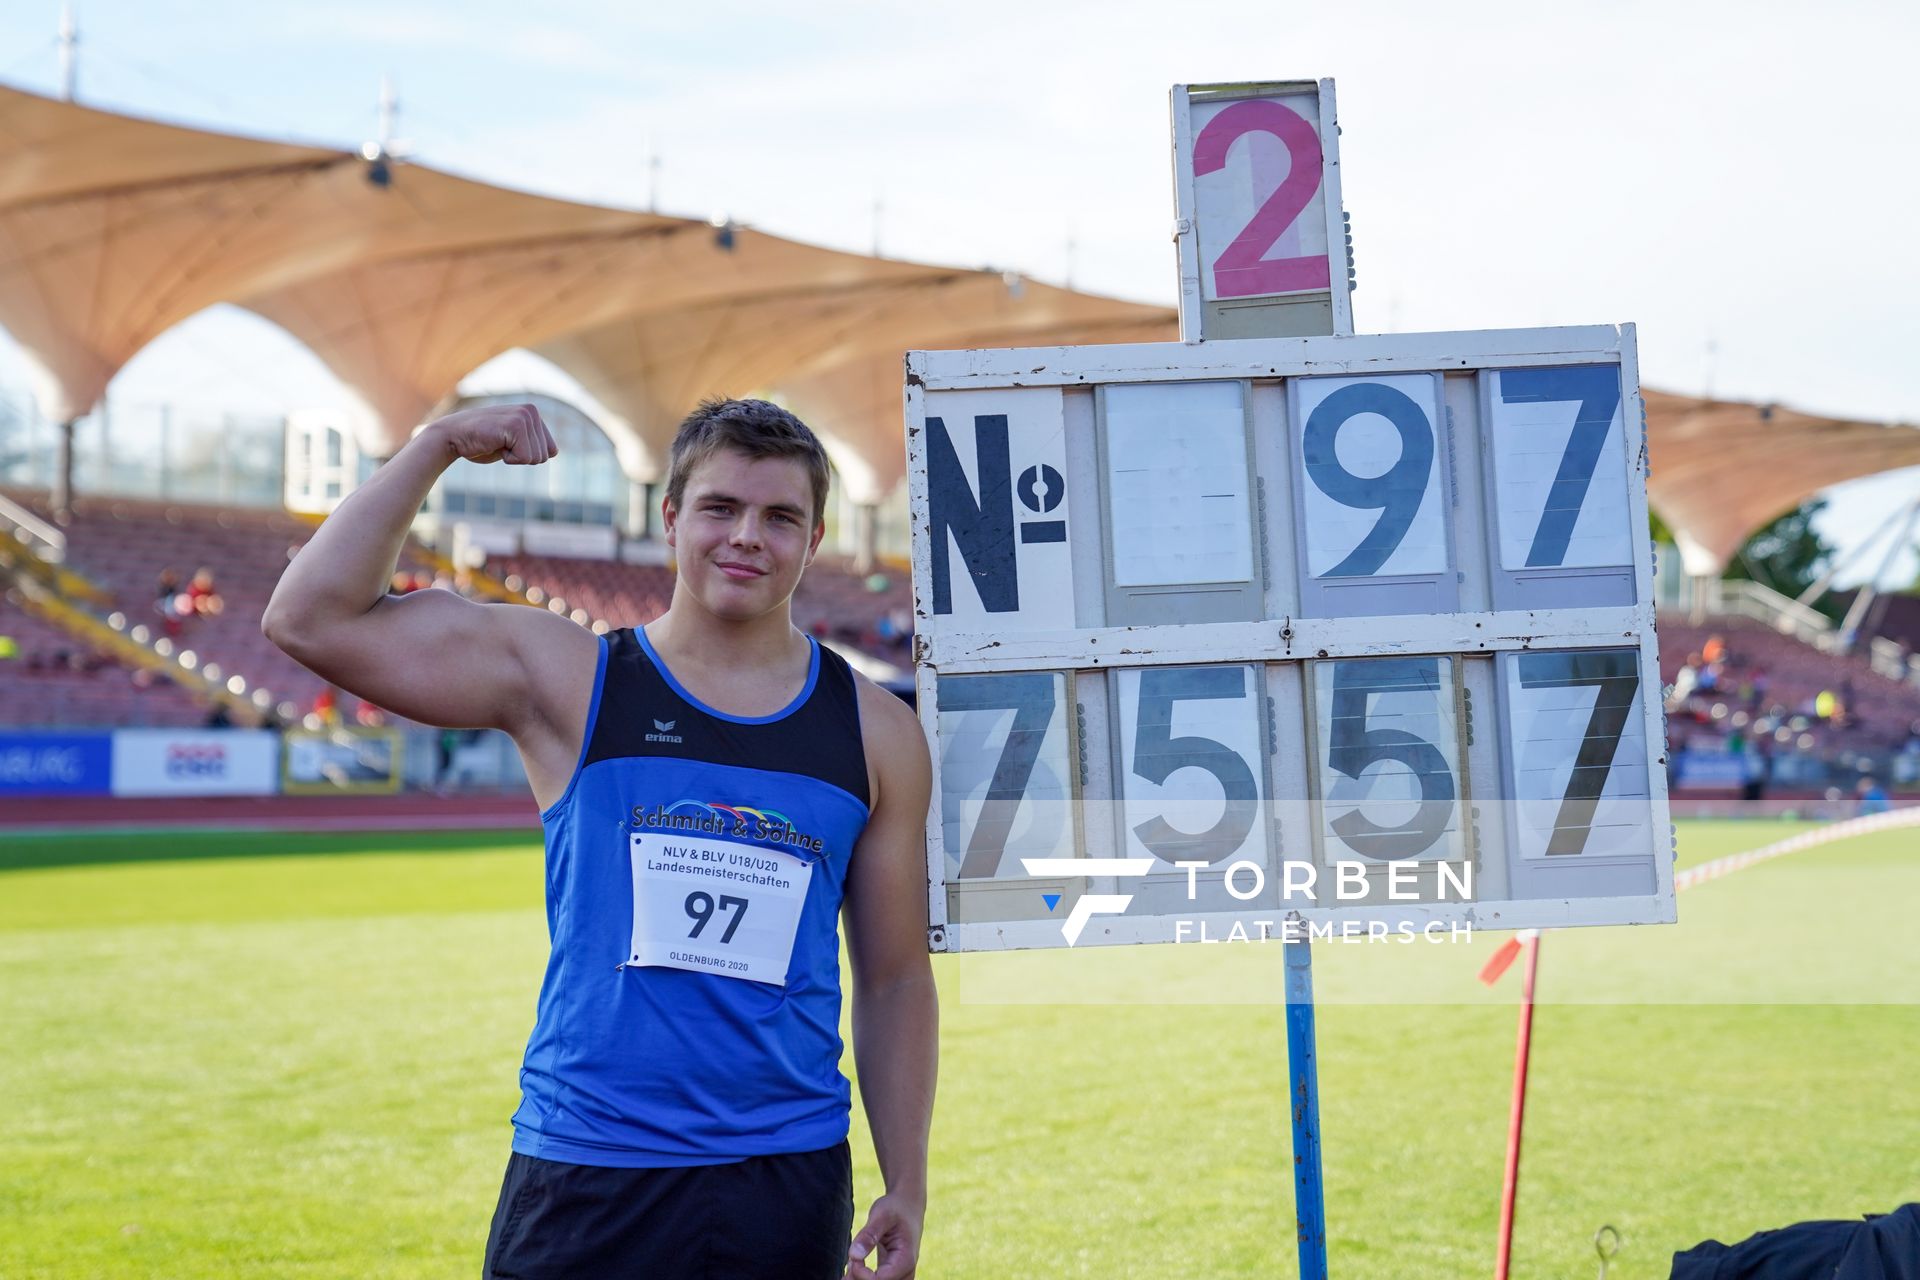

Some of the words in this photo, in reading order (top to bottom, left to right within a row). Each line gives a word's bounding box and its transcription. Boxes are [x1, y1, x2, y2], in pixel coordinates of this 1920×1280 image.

[1193, 100, 1330, 298] 2
[645, 732, 682, 744] erima
[631, 806, 725, 835] Schmidt
[731, 821, 748, 838] &
[753, 819, 824, 852] Söhne
[647, 859, 791, 890] Landesmeisterschaften
[663, 846, 689, 859] NLV
[690, 850, 699, 860] &
[701, 851, 725, 863] BLV
[729, 854, 779, 873] U18/U20
[684, 891, 749, 945] 97
[669, 951, 726, 969] OLDENBURG
[728, 960, 750, 973] 2020
